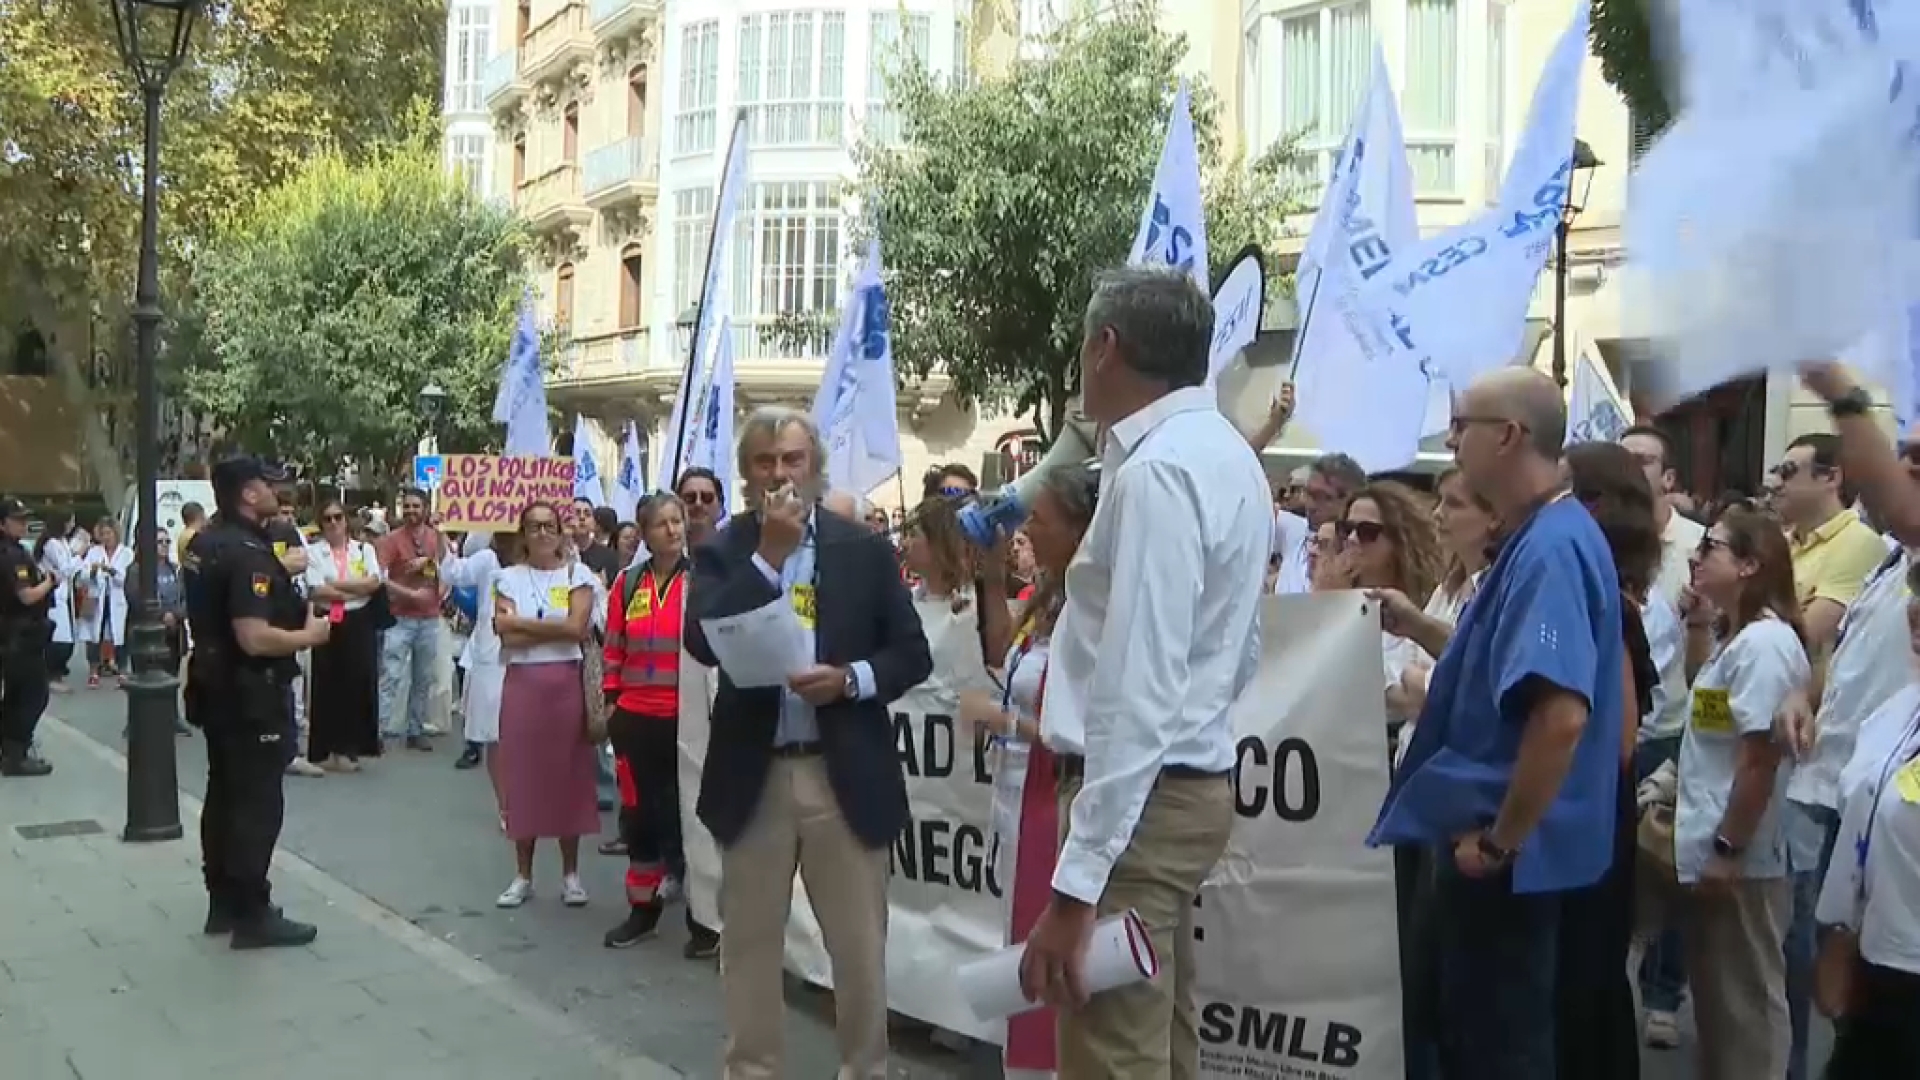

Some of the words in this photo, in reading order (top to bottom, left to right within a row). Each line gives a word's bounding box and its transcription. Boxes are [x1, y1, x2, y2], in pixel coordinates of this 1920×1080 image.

[447, 457, 491, 478] LOS
[442, 479, 486, 498] QUE
[489, 479, 514, 498] NO
[446, 500, 462, 521] A
[467, 499, 506, 522] LOS
[1199, 1002, 1362, 1067] SMLB
